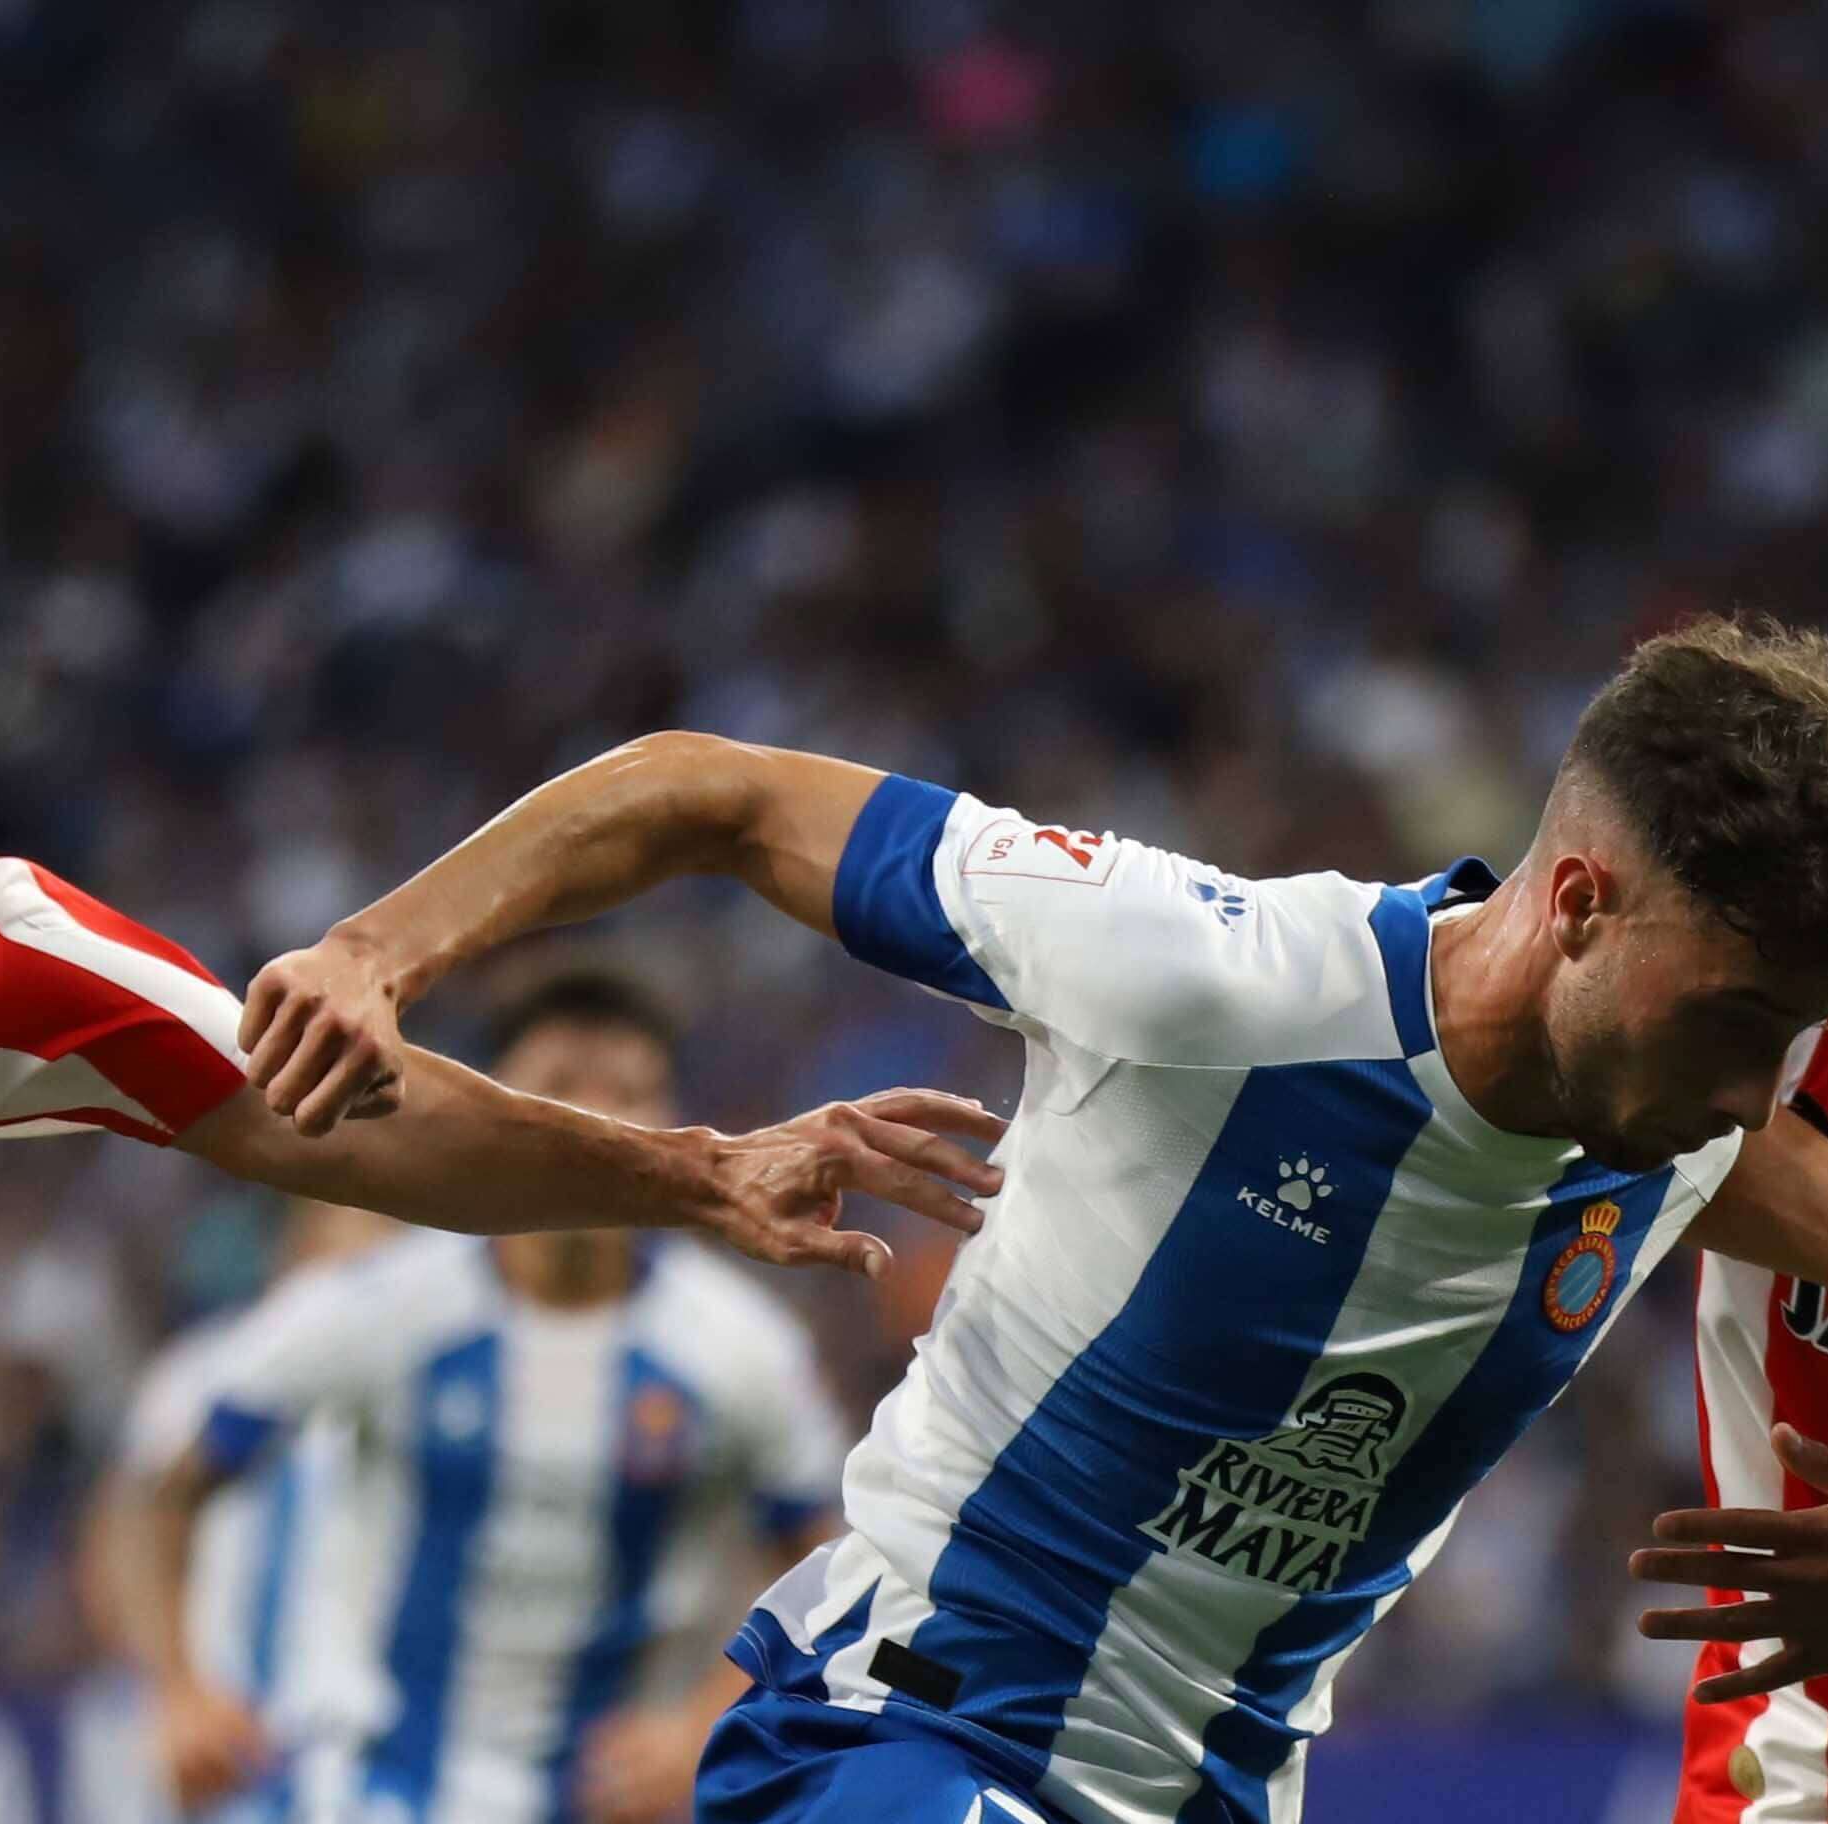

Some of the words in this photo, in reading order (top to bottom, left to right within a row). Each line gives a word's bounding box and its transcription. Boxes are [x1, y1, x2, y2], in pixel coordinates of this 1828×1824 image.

[1236, 1186, 1332, 1245] KELME
[1197, 1442, 1369, 1533] RIVIERA
[1154, 1481, 1340, 1591] MAYA
